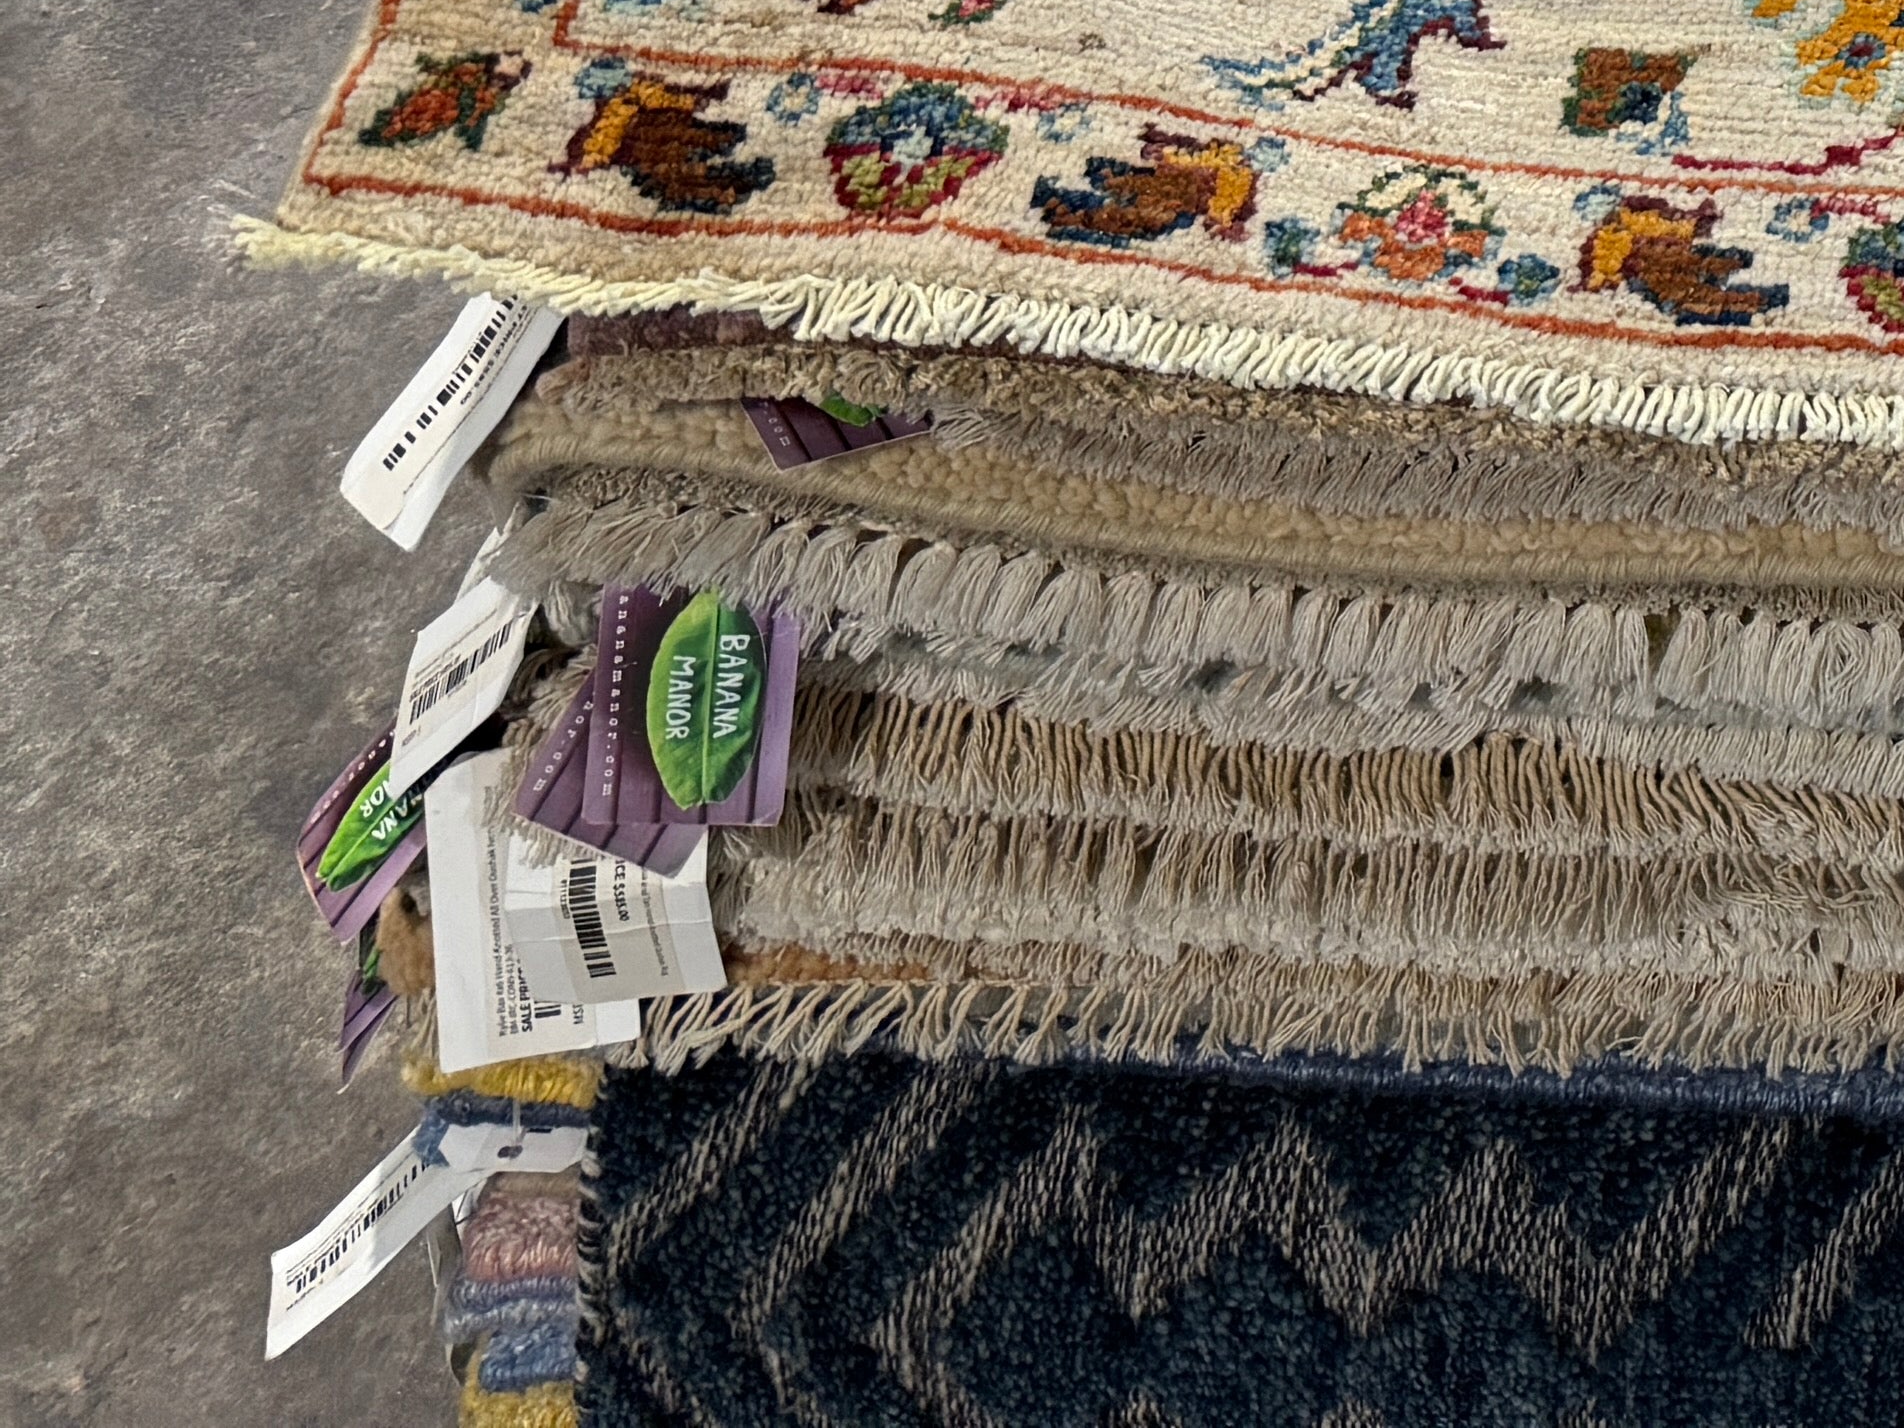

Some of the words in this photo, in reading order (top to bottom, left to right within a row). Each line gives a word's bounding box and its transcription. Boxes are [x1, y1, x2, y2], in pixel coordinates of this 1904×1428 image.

[602, 594, 629, 797] ananamanor.com
[664, 655, 697, 741] MANOR
[712, 634, 751, 739] BANANA
[532, 700, 595, 792] nor.com
[517, 968, 531, 1002] PRI
[520, 1002, 533, 1032] SALE
